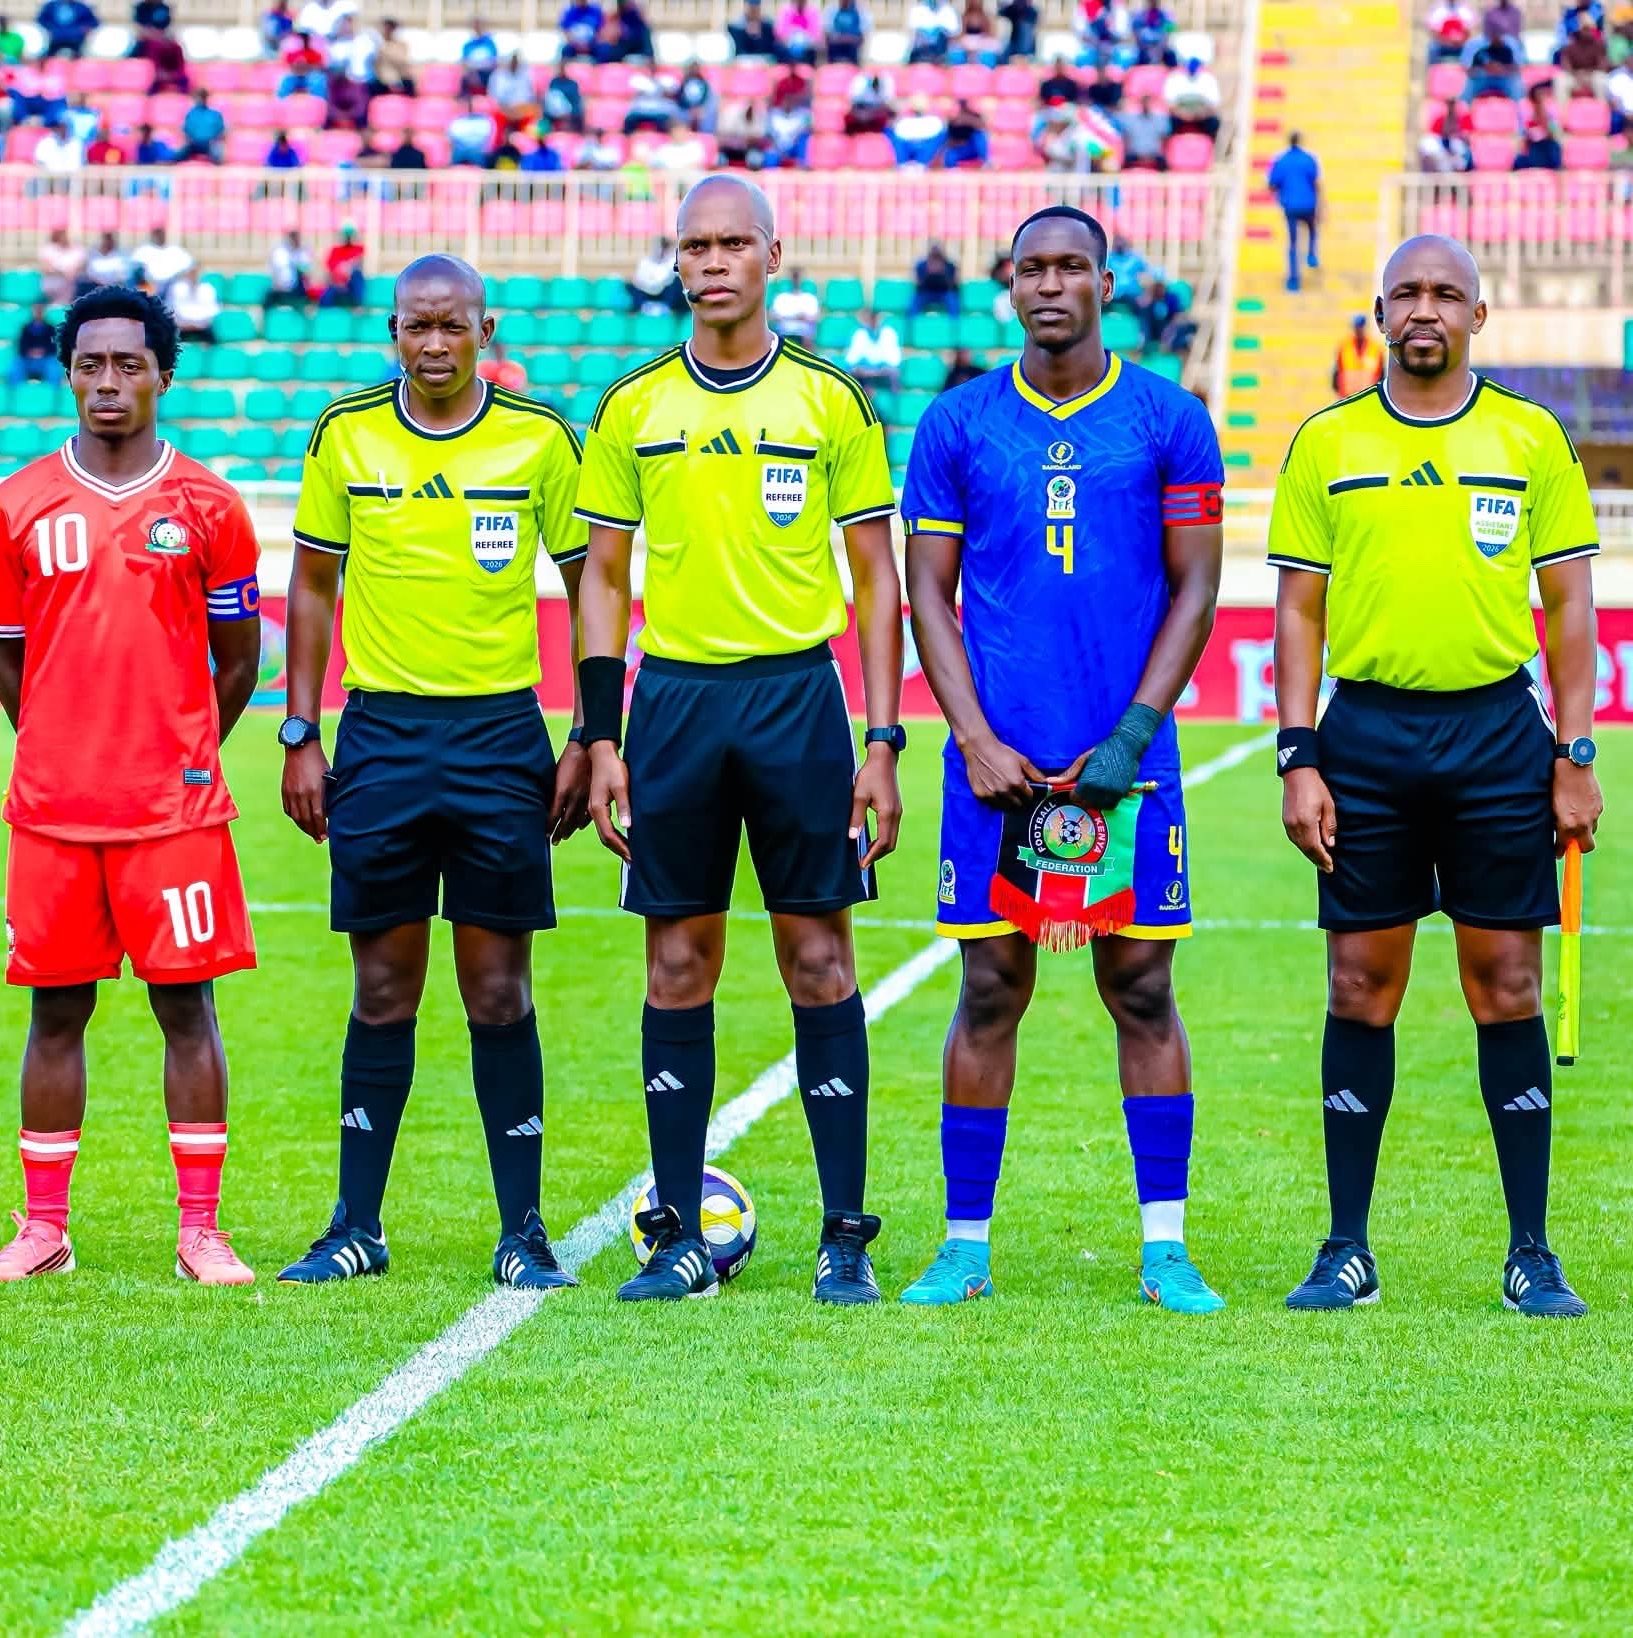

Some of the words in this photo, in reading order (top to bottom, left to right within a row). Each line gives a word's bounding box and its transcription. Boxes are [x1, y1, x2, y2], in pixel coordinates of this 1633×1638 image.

[766, 468, 803, 483] FIFA
[765, 493, 802, 502] REFEREE
[1476, 497, 1516, 516] FIFA
[475, 516, 514, 531] FIFA
[775, 513, 792, 521] 2026
[34, 512, 88, 577] 10
[475, 540, 514, 549] REFEREE
[1046, 525, 1074, 574] 4
[1482, 544, 1500, 553] 2026
[485, 560, 503, 569] 2026
[241, 582, 259, 612] C
[1033, 802, 1057, 853] FOOTBALL
[1093, 816, 1106, 854] KENYA
[1168, 824, 1183, 874] 4
[1035, 859, 1098, 874] FEDERATION
[162, 880, 215, 948] 10
